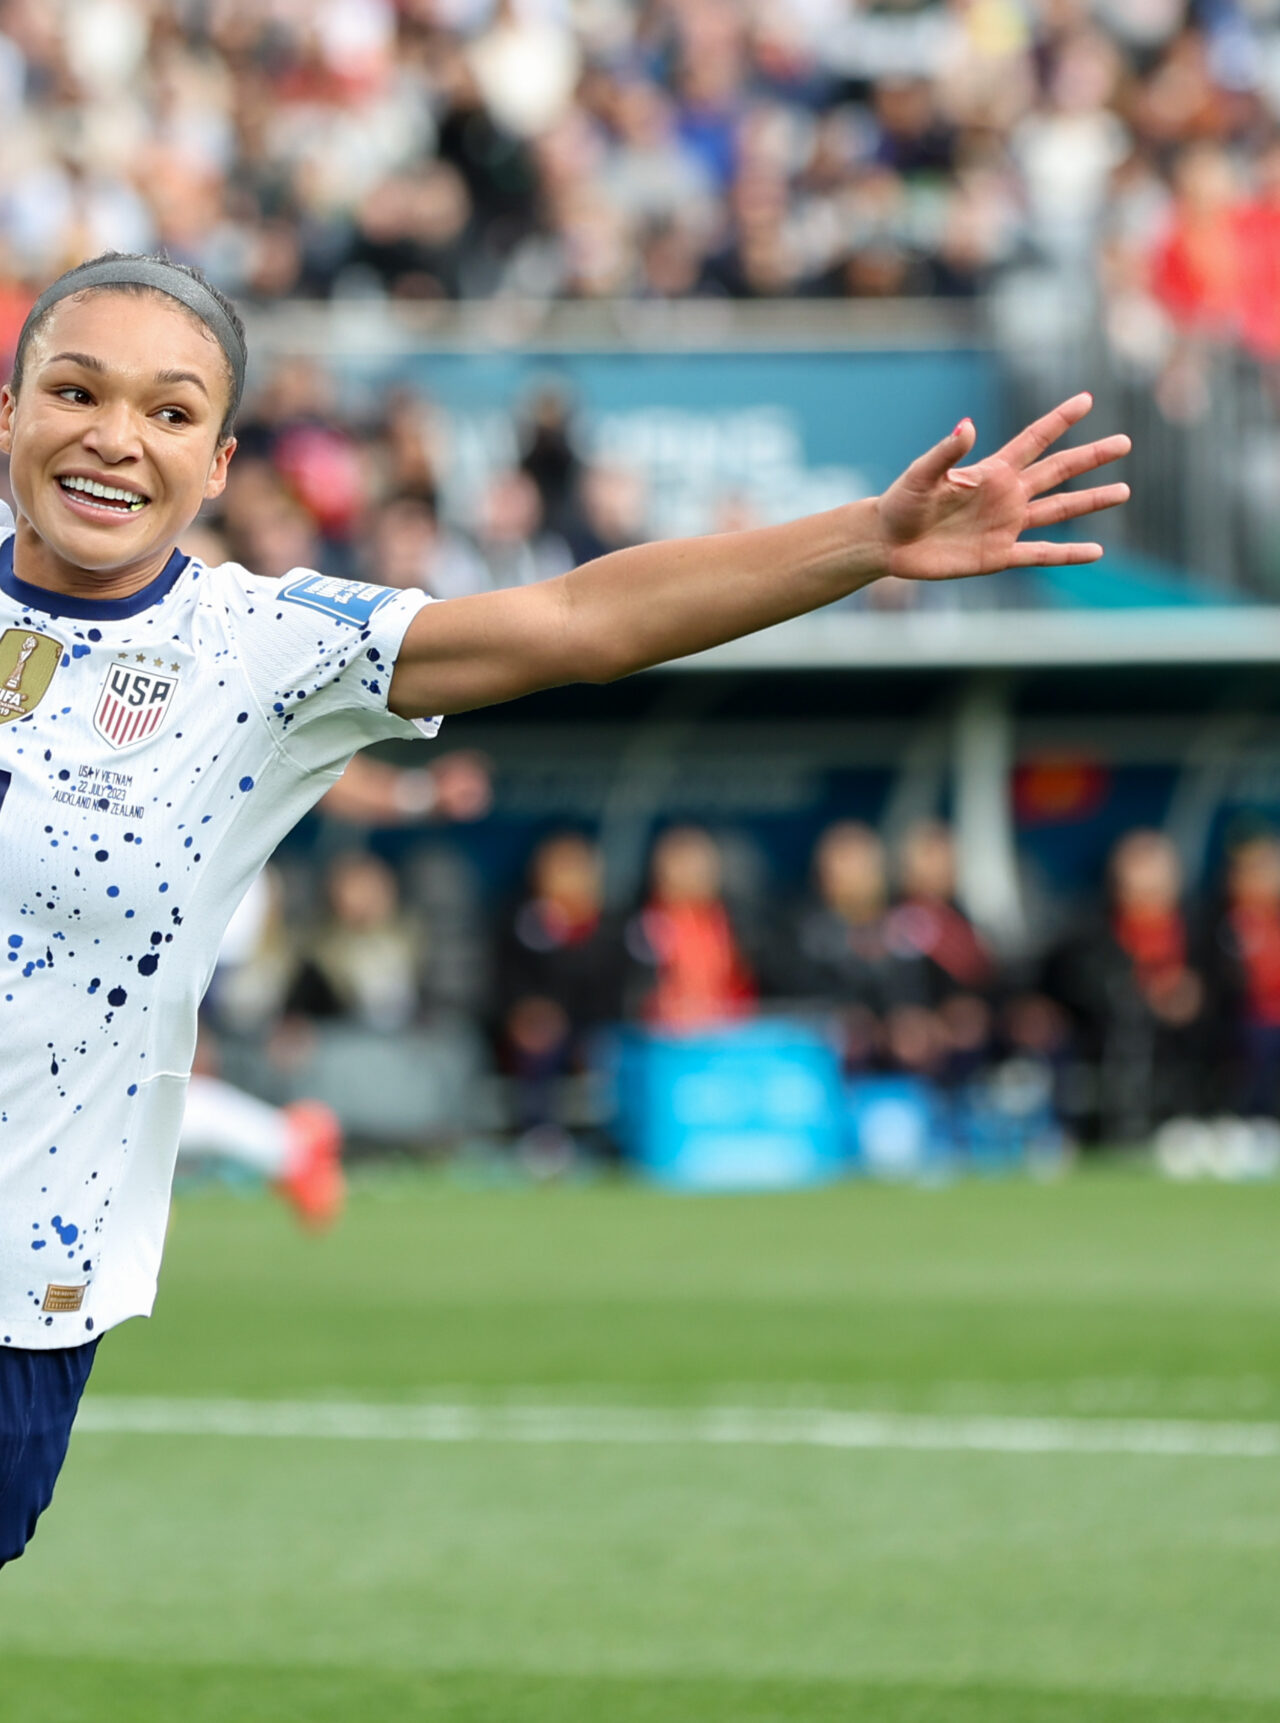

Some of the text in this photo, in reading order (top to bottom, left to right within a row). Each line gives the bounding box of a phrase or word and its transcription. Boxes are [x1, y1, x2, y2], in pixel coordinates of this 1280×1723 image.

[111, 670, 171, 706] USA
[78, 764, 93, 779] USA
[101, 769, 133, 787] VIETNAM
[78, 780, 127, 801] 22 JULY 2023
[52, 790, 145, 819] AUCKLAND NE ZEALAND
